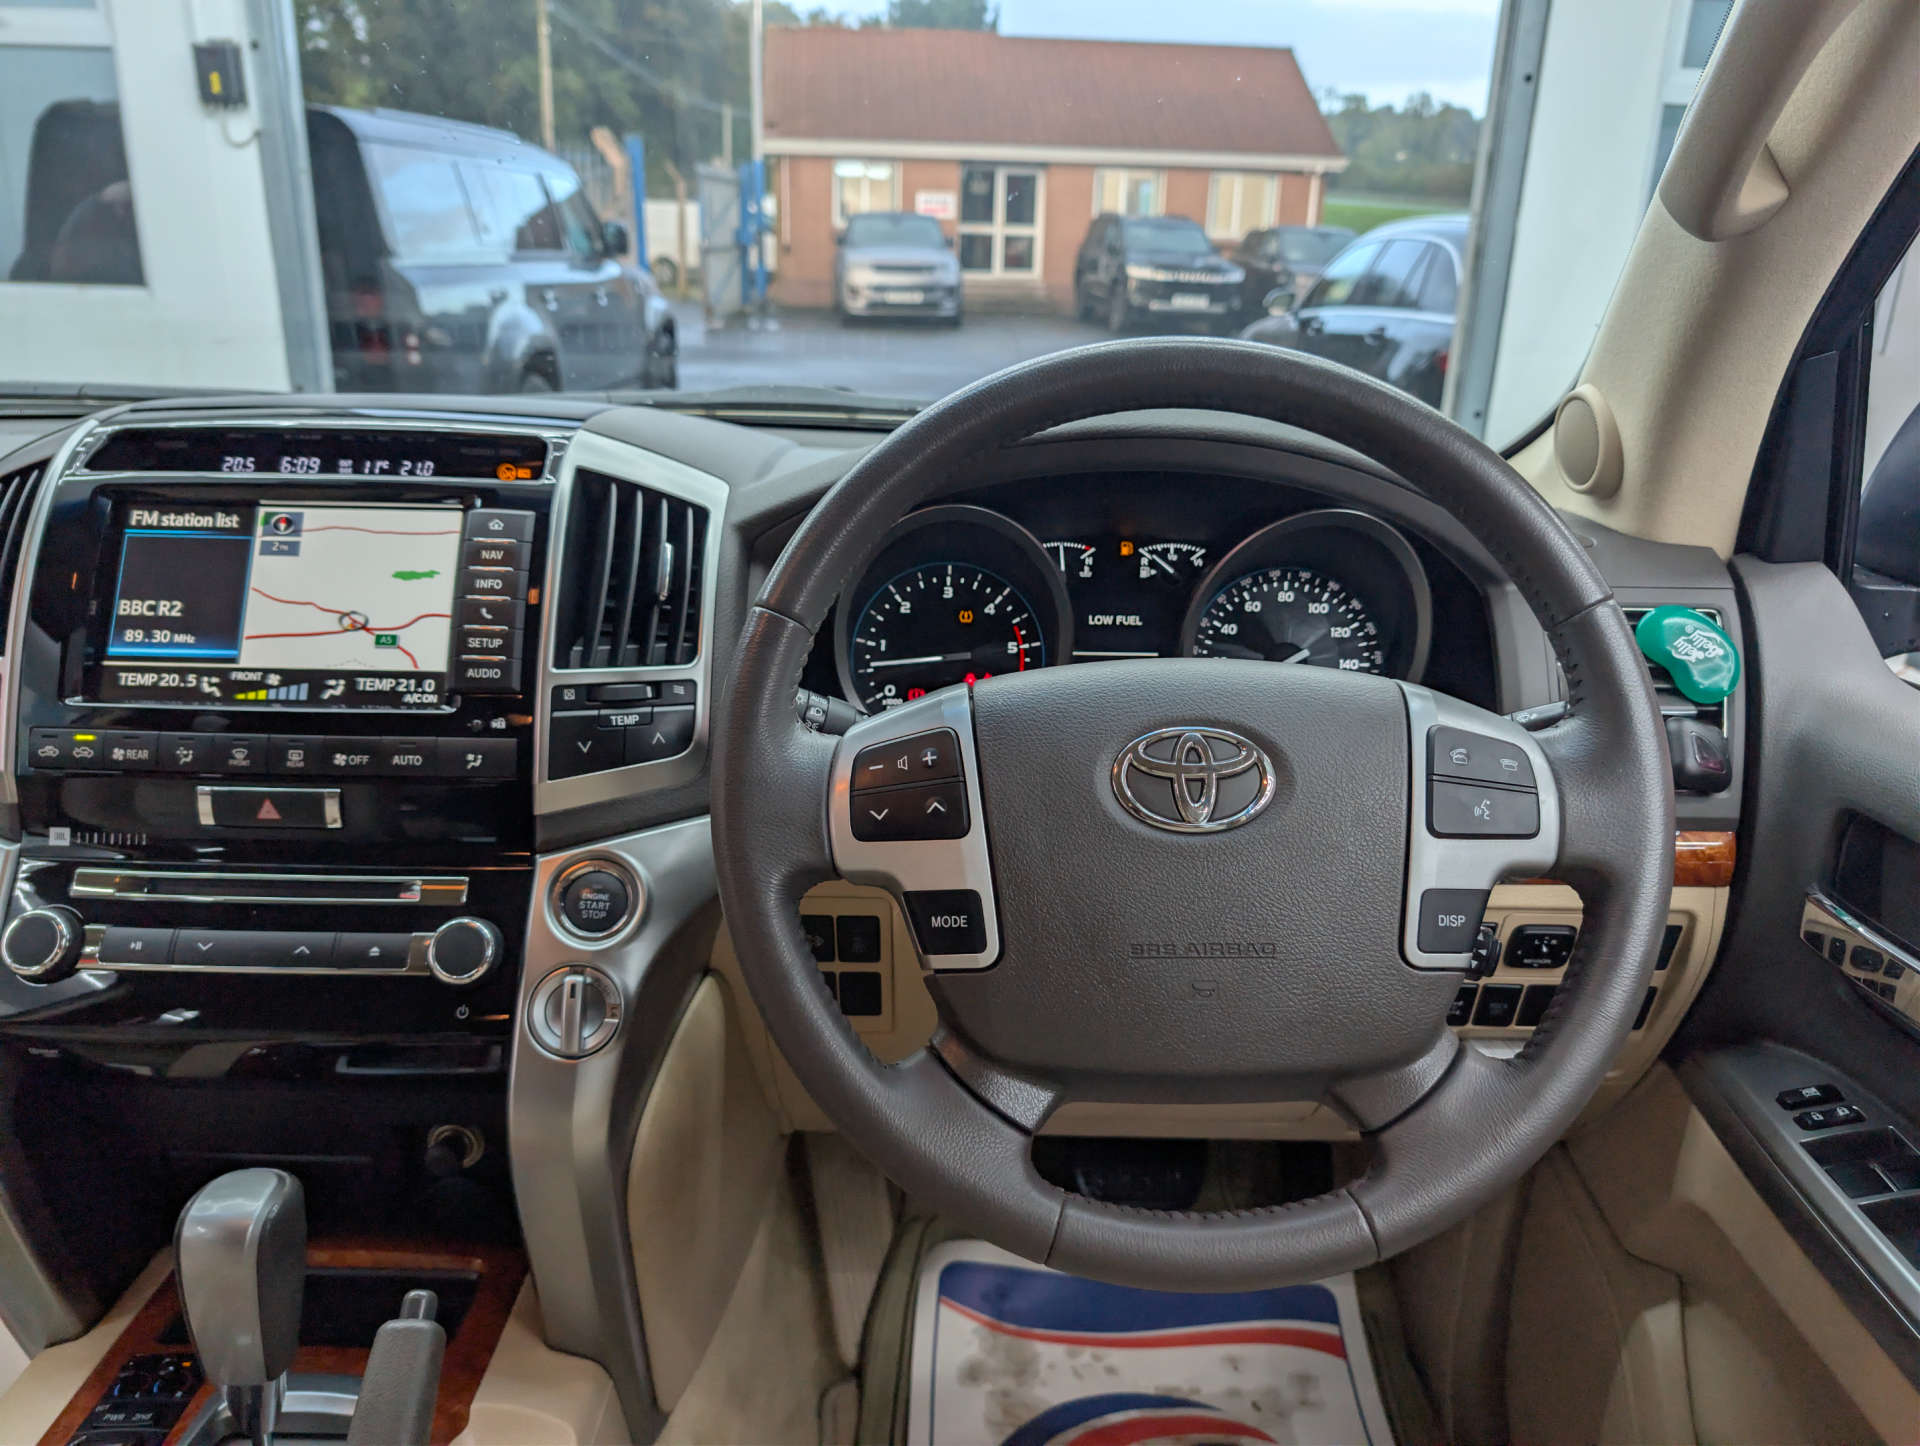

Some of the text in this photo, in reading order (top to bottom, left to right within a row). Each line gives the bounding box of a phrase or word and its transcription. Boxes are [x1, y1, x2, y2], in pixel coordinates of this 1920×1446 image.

[221, 456, 256, 472] 20.5
[279, 456, 321, 474] 6:09
[399, 460, 435, 476] 21.0
[130, 509, 240, 528] FM station list
[480, 549, 504, 560] NAV
[475, 579, 503, 590] INFO
[942, 586, 953, 599] 3
[1277, 590, 1295, 602] 80
[117, 599, 184, 617] BBC R2
[900, 601, 911, 614] 2
[983, 603, 996, 615] 4
[1244, 600, 1262, 613] 60
[1307, 602, 1330, 614] 100
[1088, 614, 1143, 626] LOW FUEL
[1220, 623, 1238, 635] 40
[1330, 626, 1352, 639] 120
[123, 628, 196, 645] 89.30 MHz
[467, 637, 504, 649] SETUP
[879, 639, 887, 652] 1
[1007, 641, 1018, 654] 5
[1338, 658, 1360, 671] 140
[230, 671, 263, 681] FRONT
[466, 667, 501, 679] AUDIO
[117, 672, 197, 688] TEMP 20.5
[356, 677, 436, 693] TEMP 21.0
[884, 684, 896, 697] 0
[609, 714, 640, 726] TEMP
[126, 748, 149, 760] REAR
[348, 755, 370, 766] OFF
[391, 755, 423, 766] AUTO
[578, 900, 611, 911] START
[581, 910, 607, 919] STOP
[931, 914, 968, 928] MODE
[1438, 914, 1466, 928] DISP
